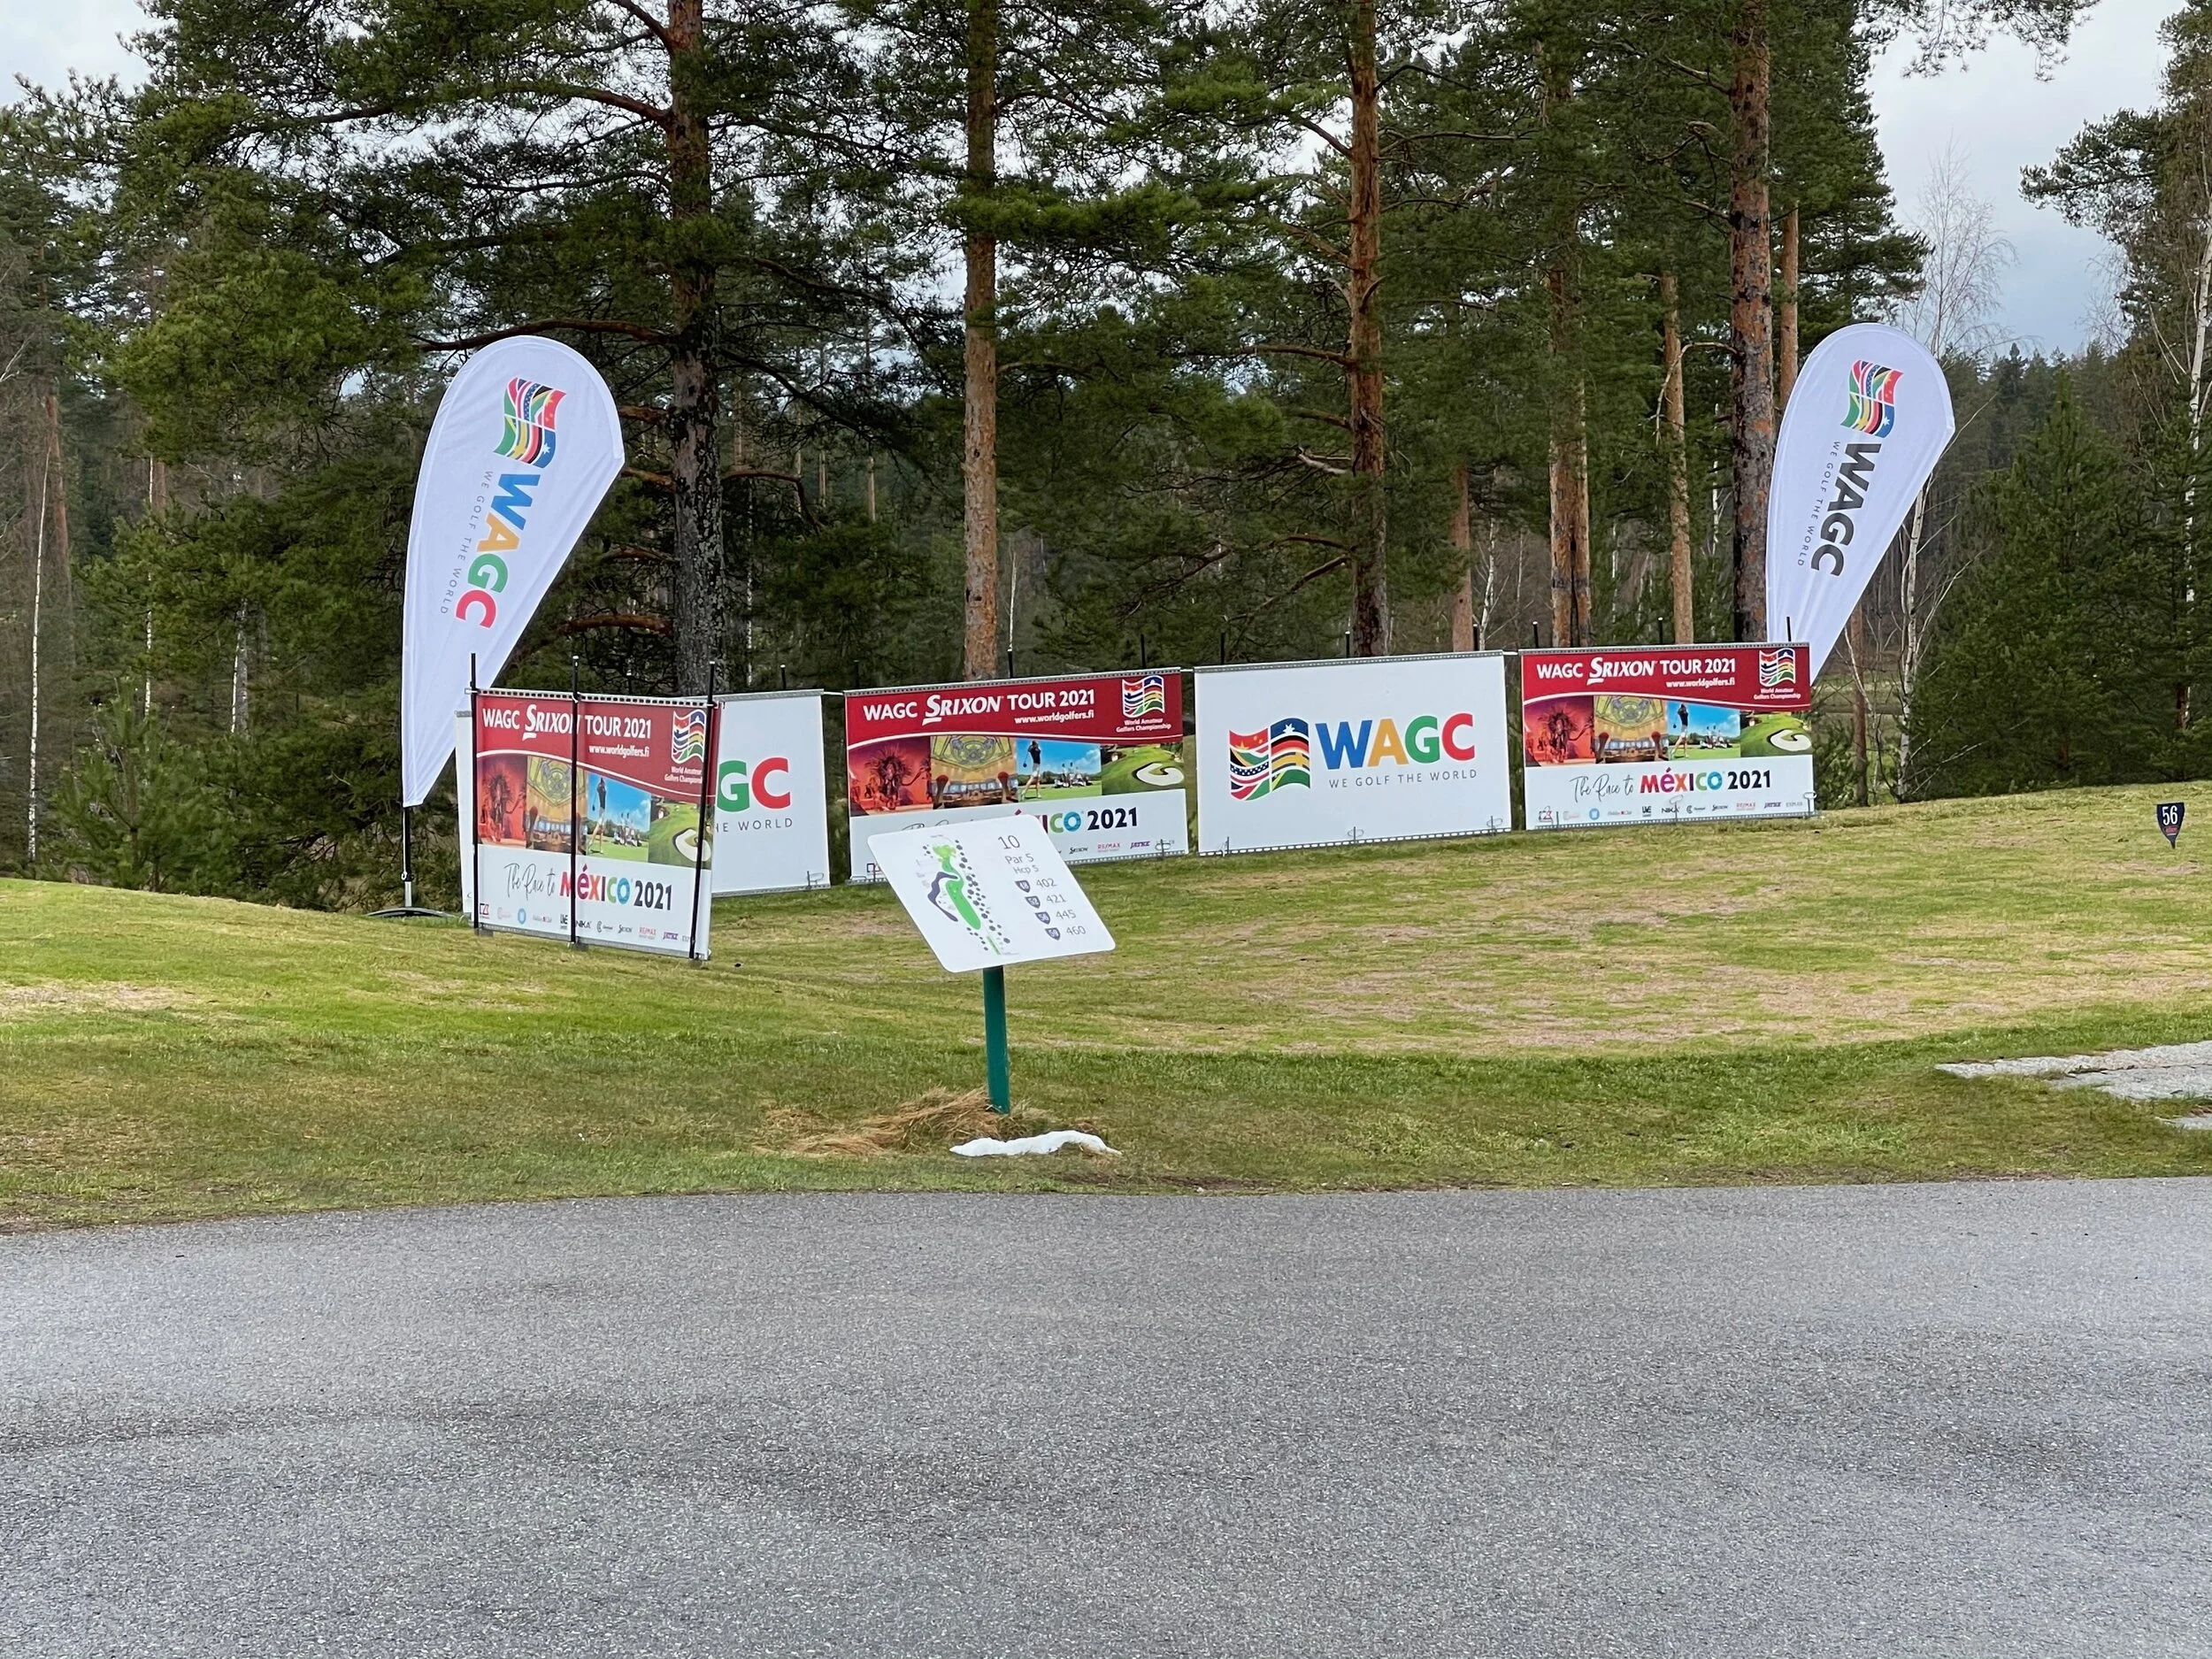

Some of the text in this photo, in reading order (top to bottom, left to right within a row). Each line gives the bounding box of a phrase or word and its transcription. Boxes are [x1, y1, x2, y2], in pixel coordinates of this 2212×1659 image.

[1797, 441, 1841, 567] WE GOLF THE WORLD
[1810, 442, 1882, 577] WAGC
[440, 470, 494, 614] WE GOLF THE WORLD
[455, 473, 541, 629] WAGC
[1536, 657, 1735, 686] WAGC SRIXON TOUR 2021
[1665, 678, 1735, 689] www.worldgolfers.fi
[863, 688, 1095, 726] WAGC SRIXON TOUR 2021
[1014, 710, 1094, 725] www.worldgolfers.fi
[482, 703, 651, 741] WAGC SRIXON TOUR 2021
[588, 743, 649, 758] www.worldgolfers.fi
[1315, 713, 1476, 770] WAGC
[717, 757, 792, 813] GC
[1329, 769, 1478, 788] WE GOLF THE WORLD
[1570, 776, 1592, 803] The
[1594, 773, 1620, 797] Race
[1623, 775, 1633, 795] to
[1727, 770, 1770, 790] 2021
[738, 817, 794, 832] WORLD
[1087, 807, 1138, 831] 2021
[2162, 805, 2178, 826] 56
[998, 834, 1020, 849] 10
[1004, 853, 1034, 864] Par 5
[503, 863, 522, 898] The
[524, 863, 543, 902] Race
[546, 867, 557, 897] to
[634, 879, 672, 911] 2021
[1036, 878, 1057, 888] 402
[1046, 894, 1066, 903] 421
[1056, 909, 1077, 919] 445
[1066, 926, 1087, 935] 460
